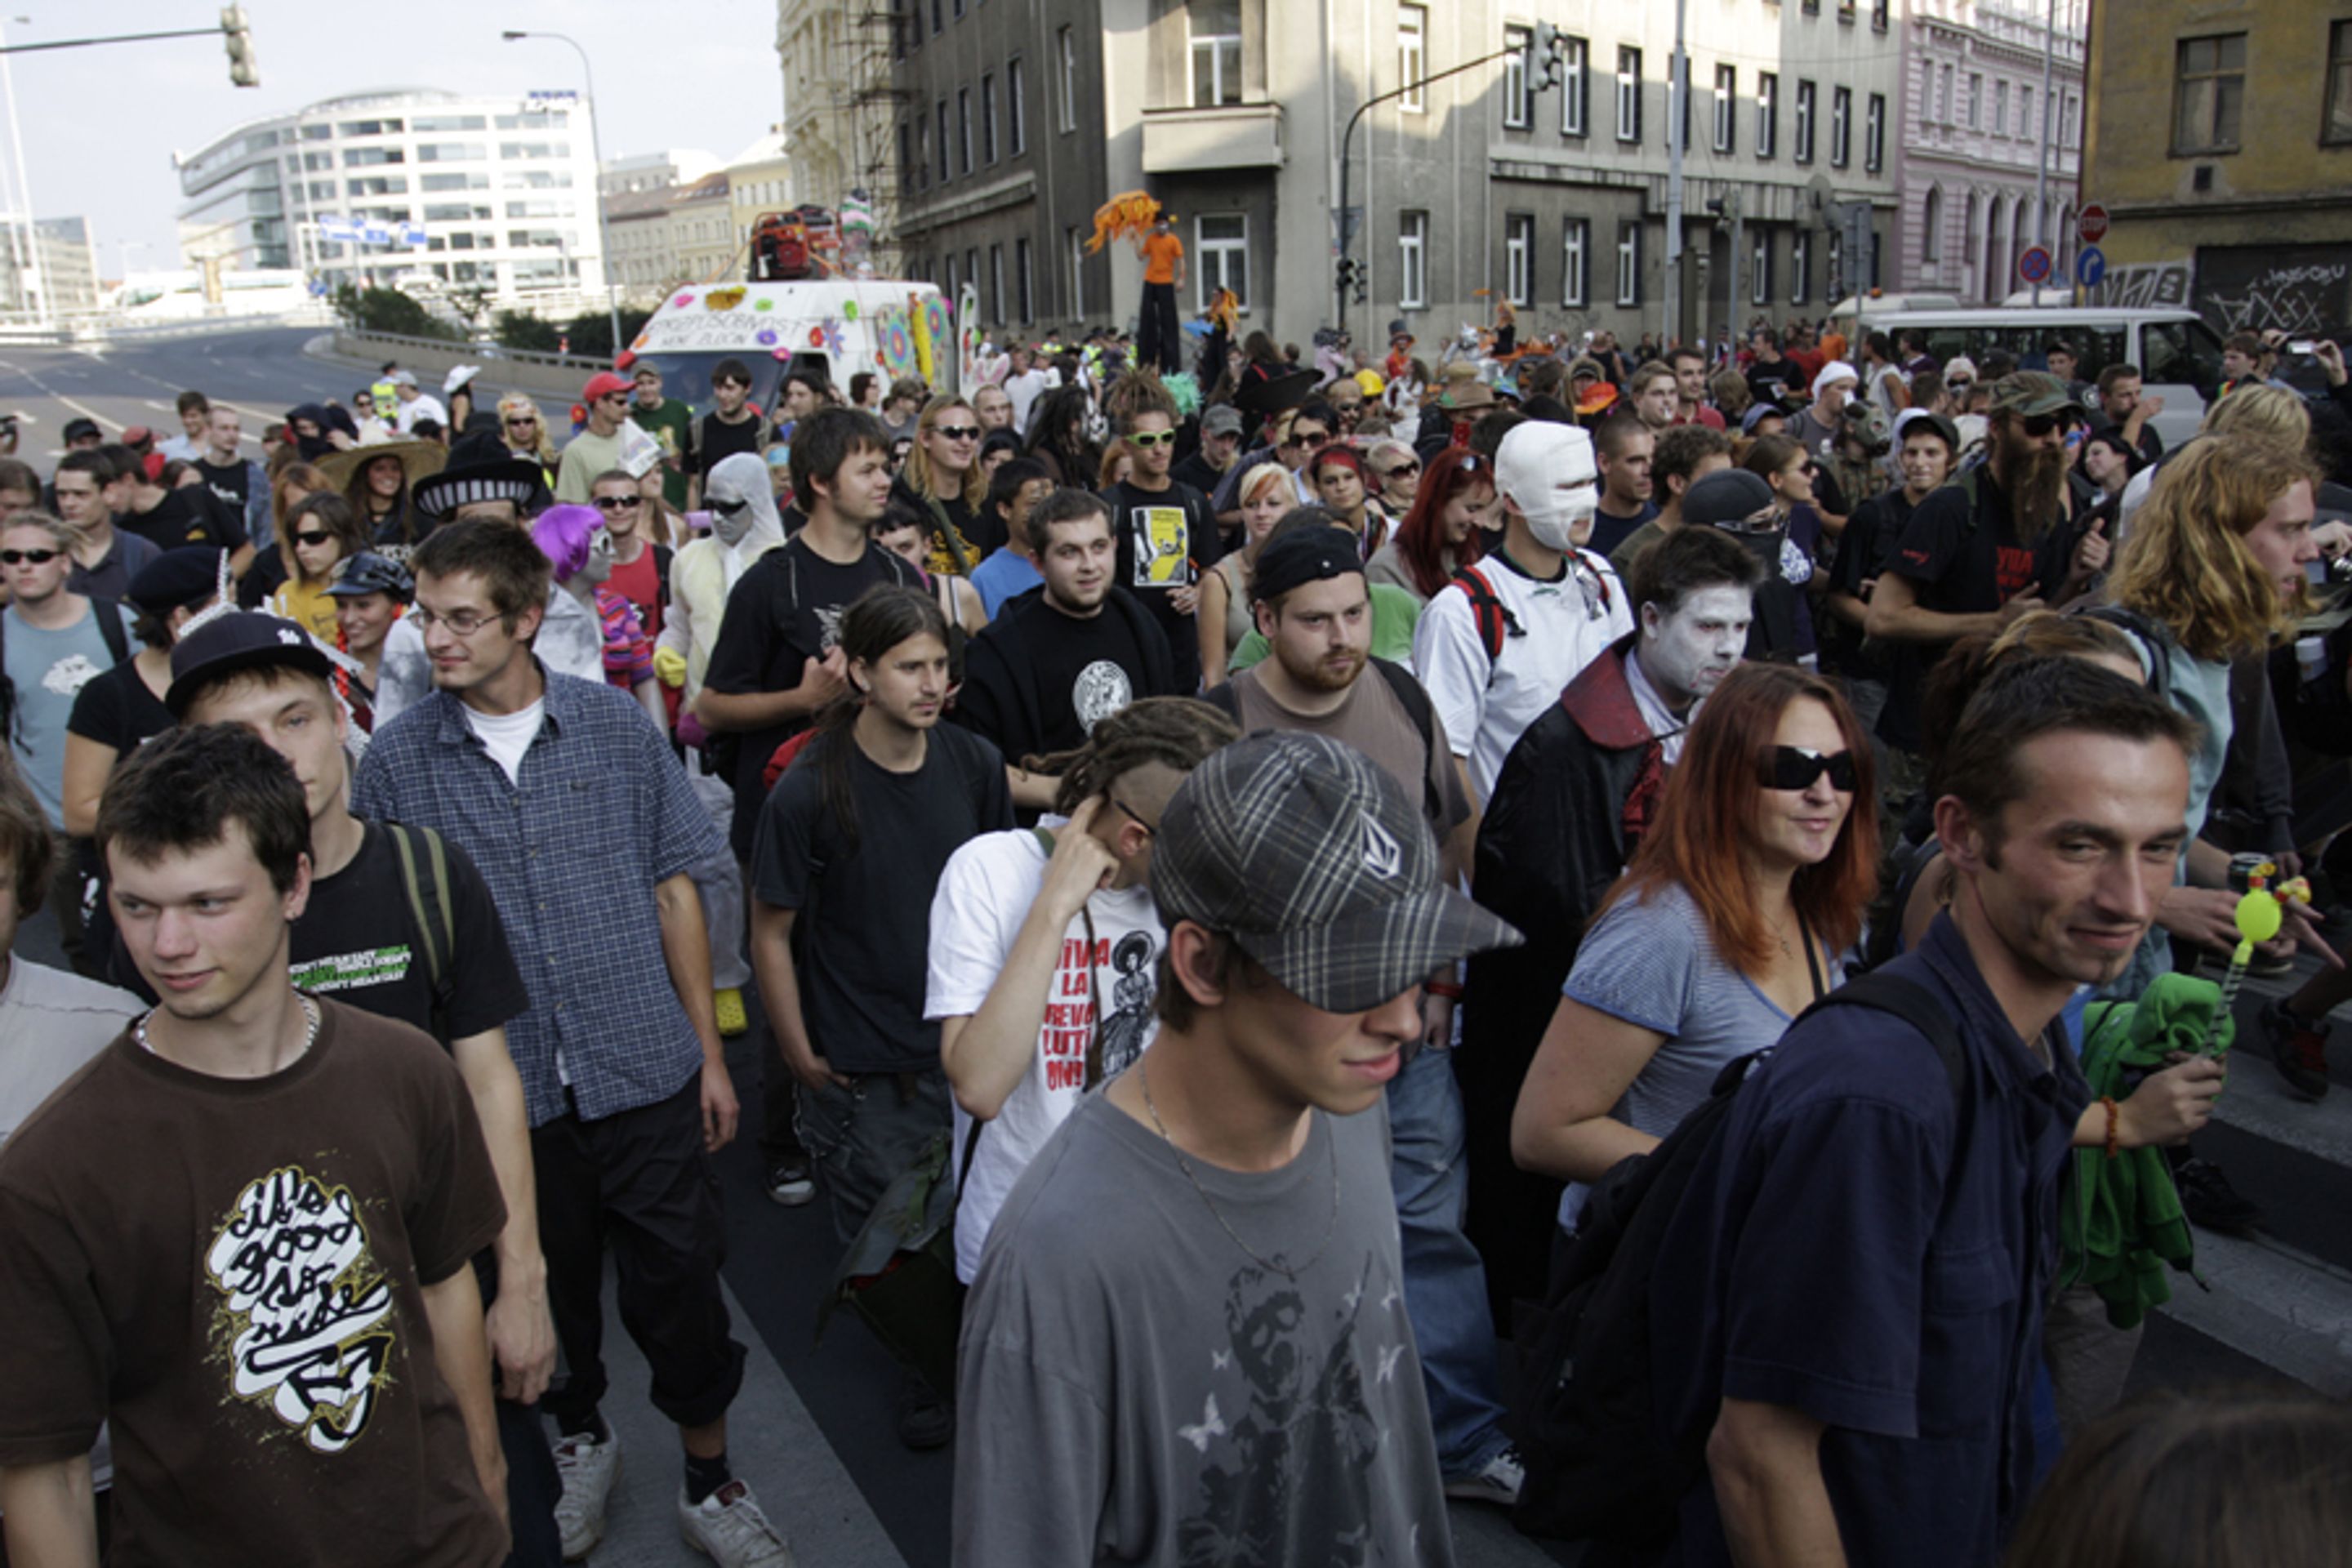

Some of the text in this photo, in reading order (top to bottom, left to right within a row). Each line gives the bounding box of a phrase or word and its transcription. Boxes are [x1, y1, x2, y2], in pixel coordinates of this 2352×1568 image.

[2080, 216, 2107, 232] STOP
[1062, 972, 1087, 996] LA
[1046, 1059, 1085, 1091] ON!
[229, 1189, 365, 1294] good
